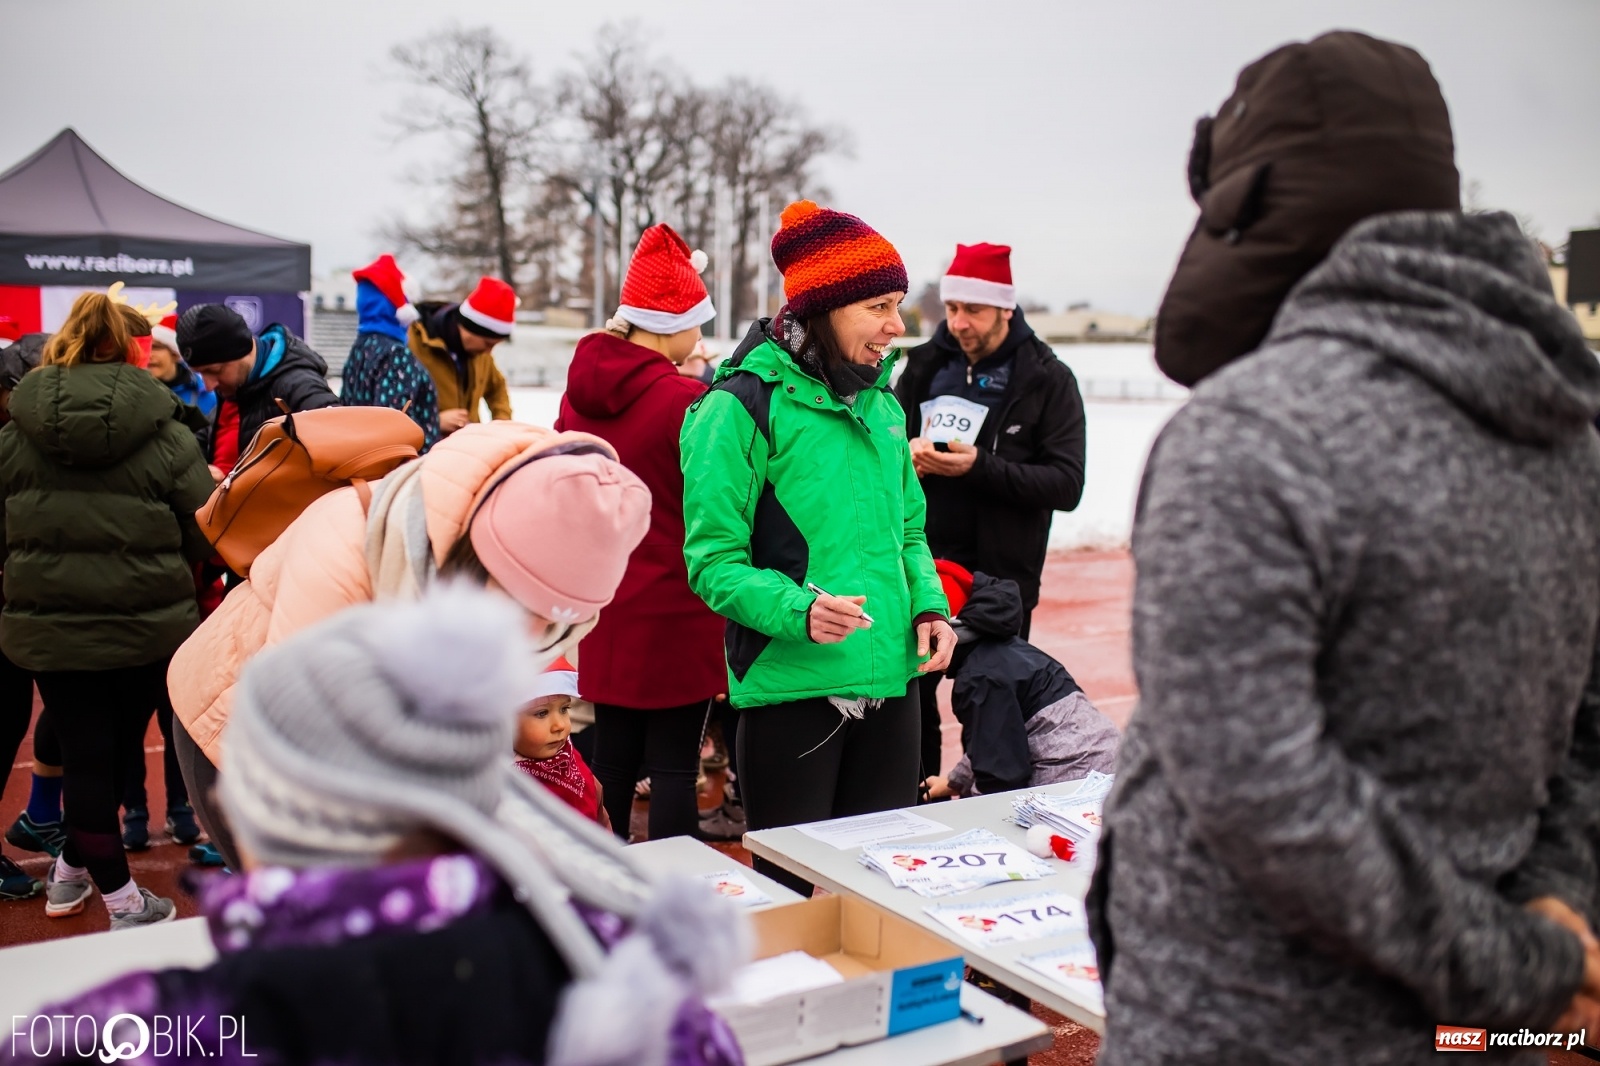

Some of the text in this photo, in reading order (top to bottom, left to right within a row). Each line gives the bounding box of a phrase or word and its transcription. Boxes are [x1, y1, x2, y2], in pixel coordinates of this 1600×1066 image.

[25, 253, 194, 277] www.raciborz.pl
[931, 413, 971, 433] 039
[930, 852, 1007, 869] 207
[998, 905, 1072, 926] 174
